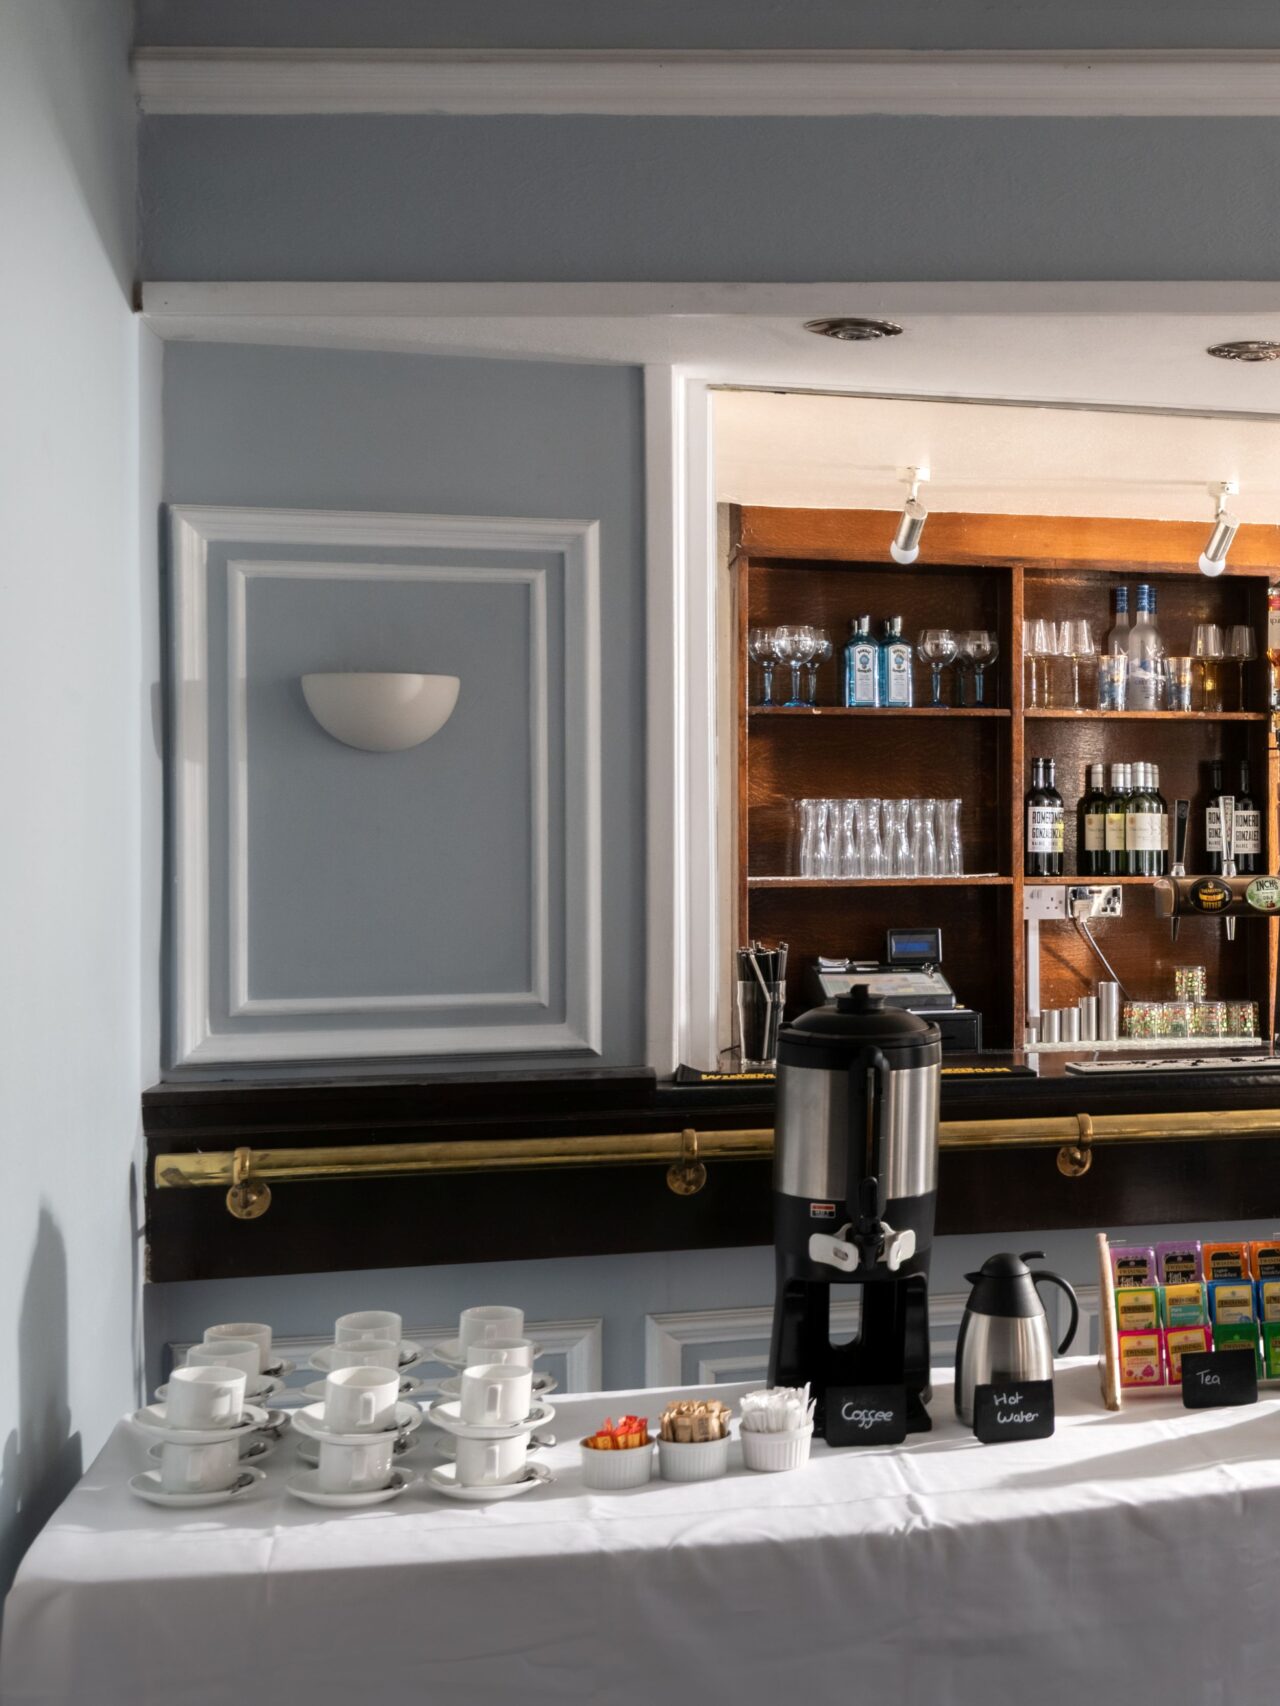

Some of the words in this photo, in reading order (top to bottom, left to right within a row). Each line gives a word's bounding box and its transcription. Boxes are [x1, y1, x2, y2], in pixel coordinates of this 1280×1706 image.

[1196, 1369, 1221, 1385] Tea
[993, 1391, 1024, 1406] Hot
[841, 1402, 893, 1429] Coffee
